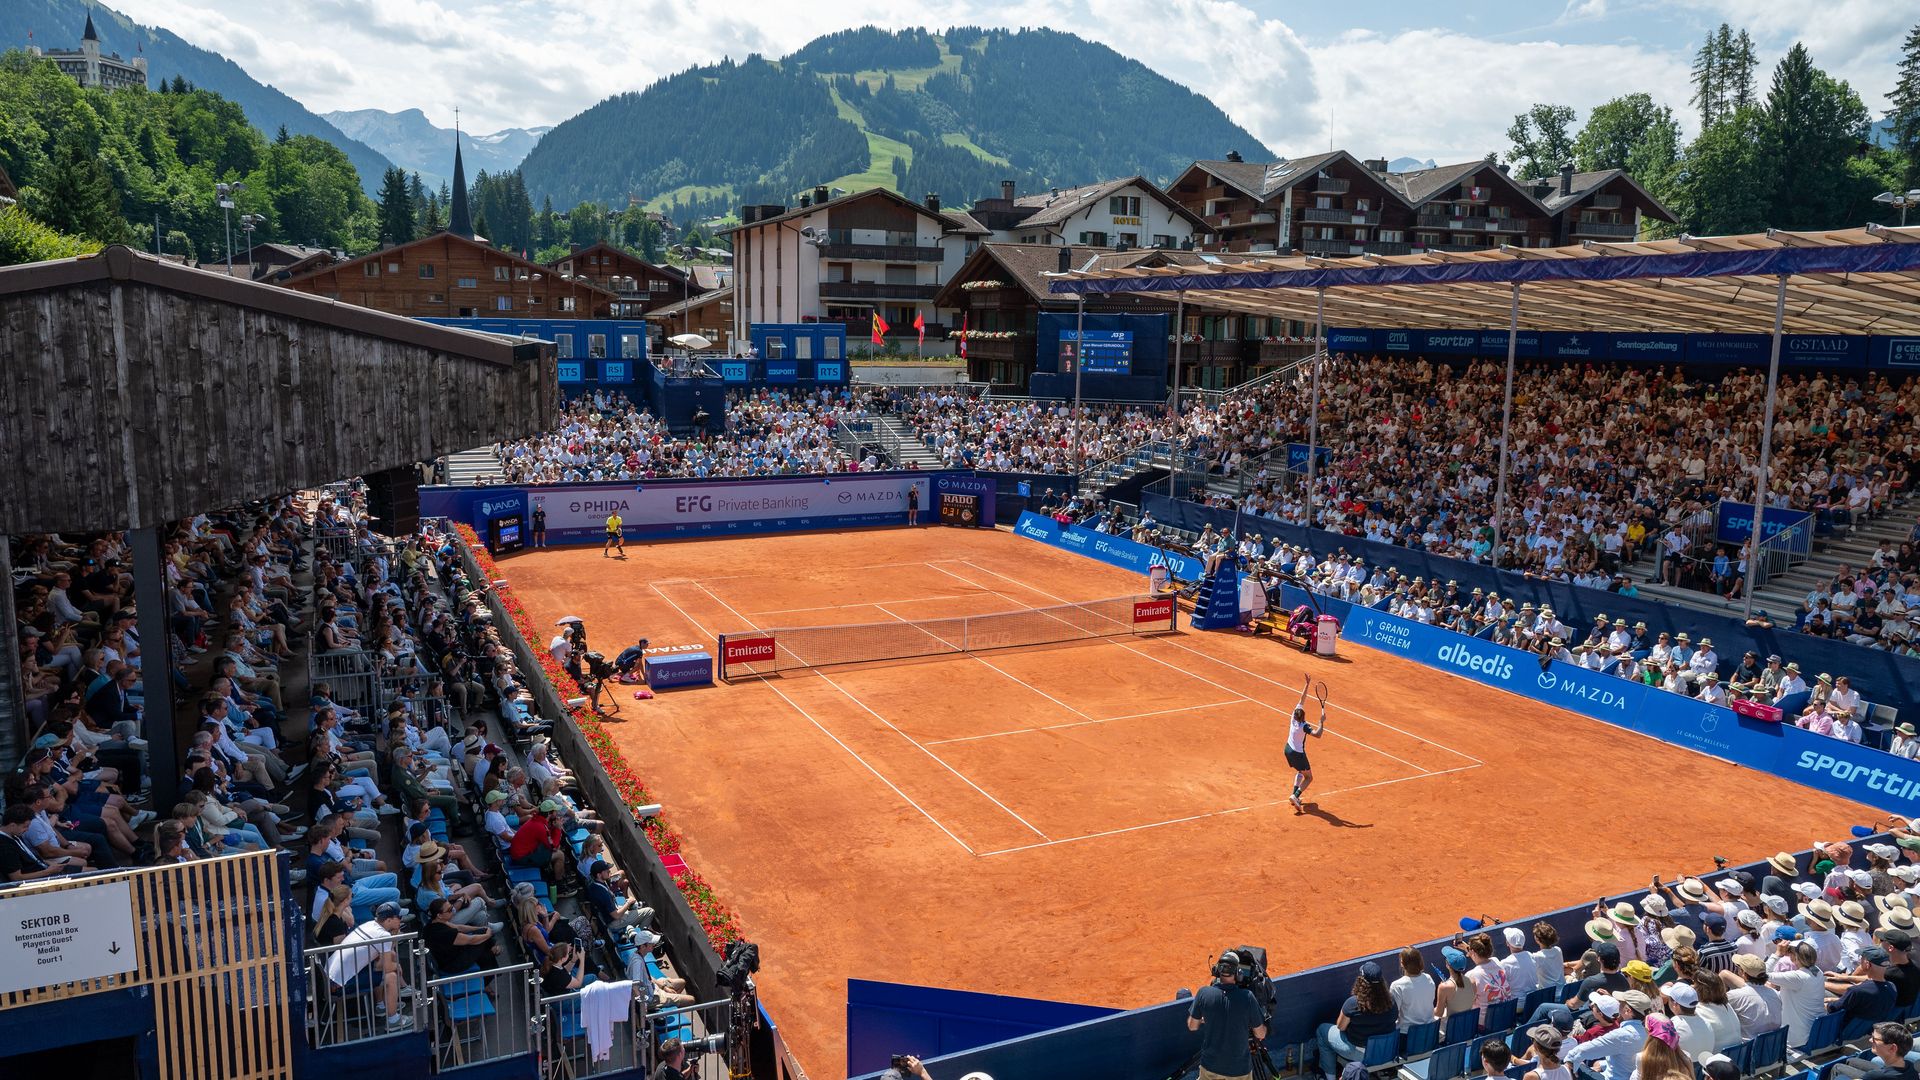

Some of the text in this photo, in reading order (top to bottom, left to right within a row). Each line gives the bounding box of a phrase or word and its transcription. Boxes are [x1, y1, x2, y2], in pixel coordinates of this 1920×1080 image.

[1113, 216, 1142, 225] HOTEL
[1558, 346, 1589, 355] Heineken
[1616, 341, 1678, 352] SonntagsZeitung
[1790, 339, 1848, 350] GSTAAD
[558, 367, 578, 377] RTS
[725, 367, 744, 376] RTS
[820, 367, 838, 376] RTS
[951, 481, 988, 491] MAZDA
[857, 491, 903, 501] MAZDA
[944, 496, 973, 504] RADO
[491, 498, 521, 511] VANDA
[584, 500, 630, 512] PHIDA
[676, 495, 809, 513] EFG Private Banking
[1026, 526, 1049, 539] CELESTE
[1095, 540, 1109, 552] EFG
[1149, 552, 1185, 573] RADO
[1136, 604, 1170, 617] Emirates
[1379, 621, 1410, 637] GRAND
[1375, 633, 1411, 650] CHELEM
[642, 643, 704, 654] GSTAA
[728, 644, 773, 658] Emirates
[1437, 642, 1514, 680] albedis
[671, 667, 708, 678] e-novinfo
[1560, 679, 1626, 710] MAZDA
[1684, 732, 1703, 742] GRAND
[1703, 738, 1730, 750] BELLEVUE
[21, 913, 70, 929] SEKTOR B
[15, 928, 63, 942] International
[22, 935, 73, 949] Players Guest
[37, 946, 60, 955] Media
[37, 956, 58, 965] Court
